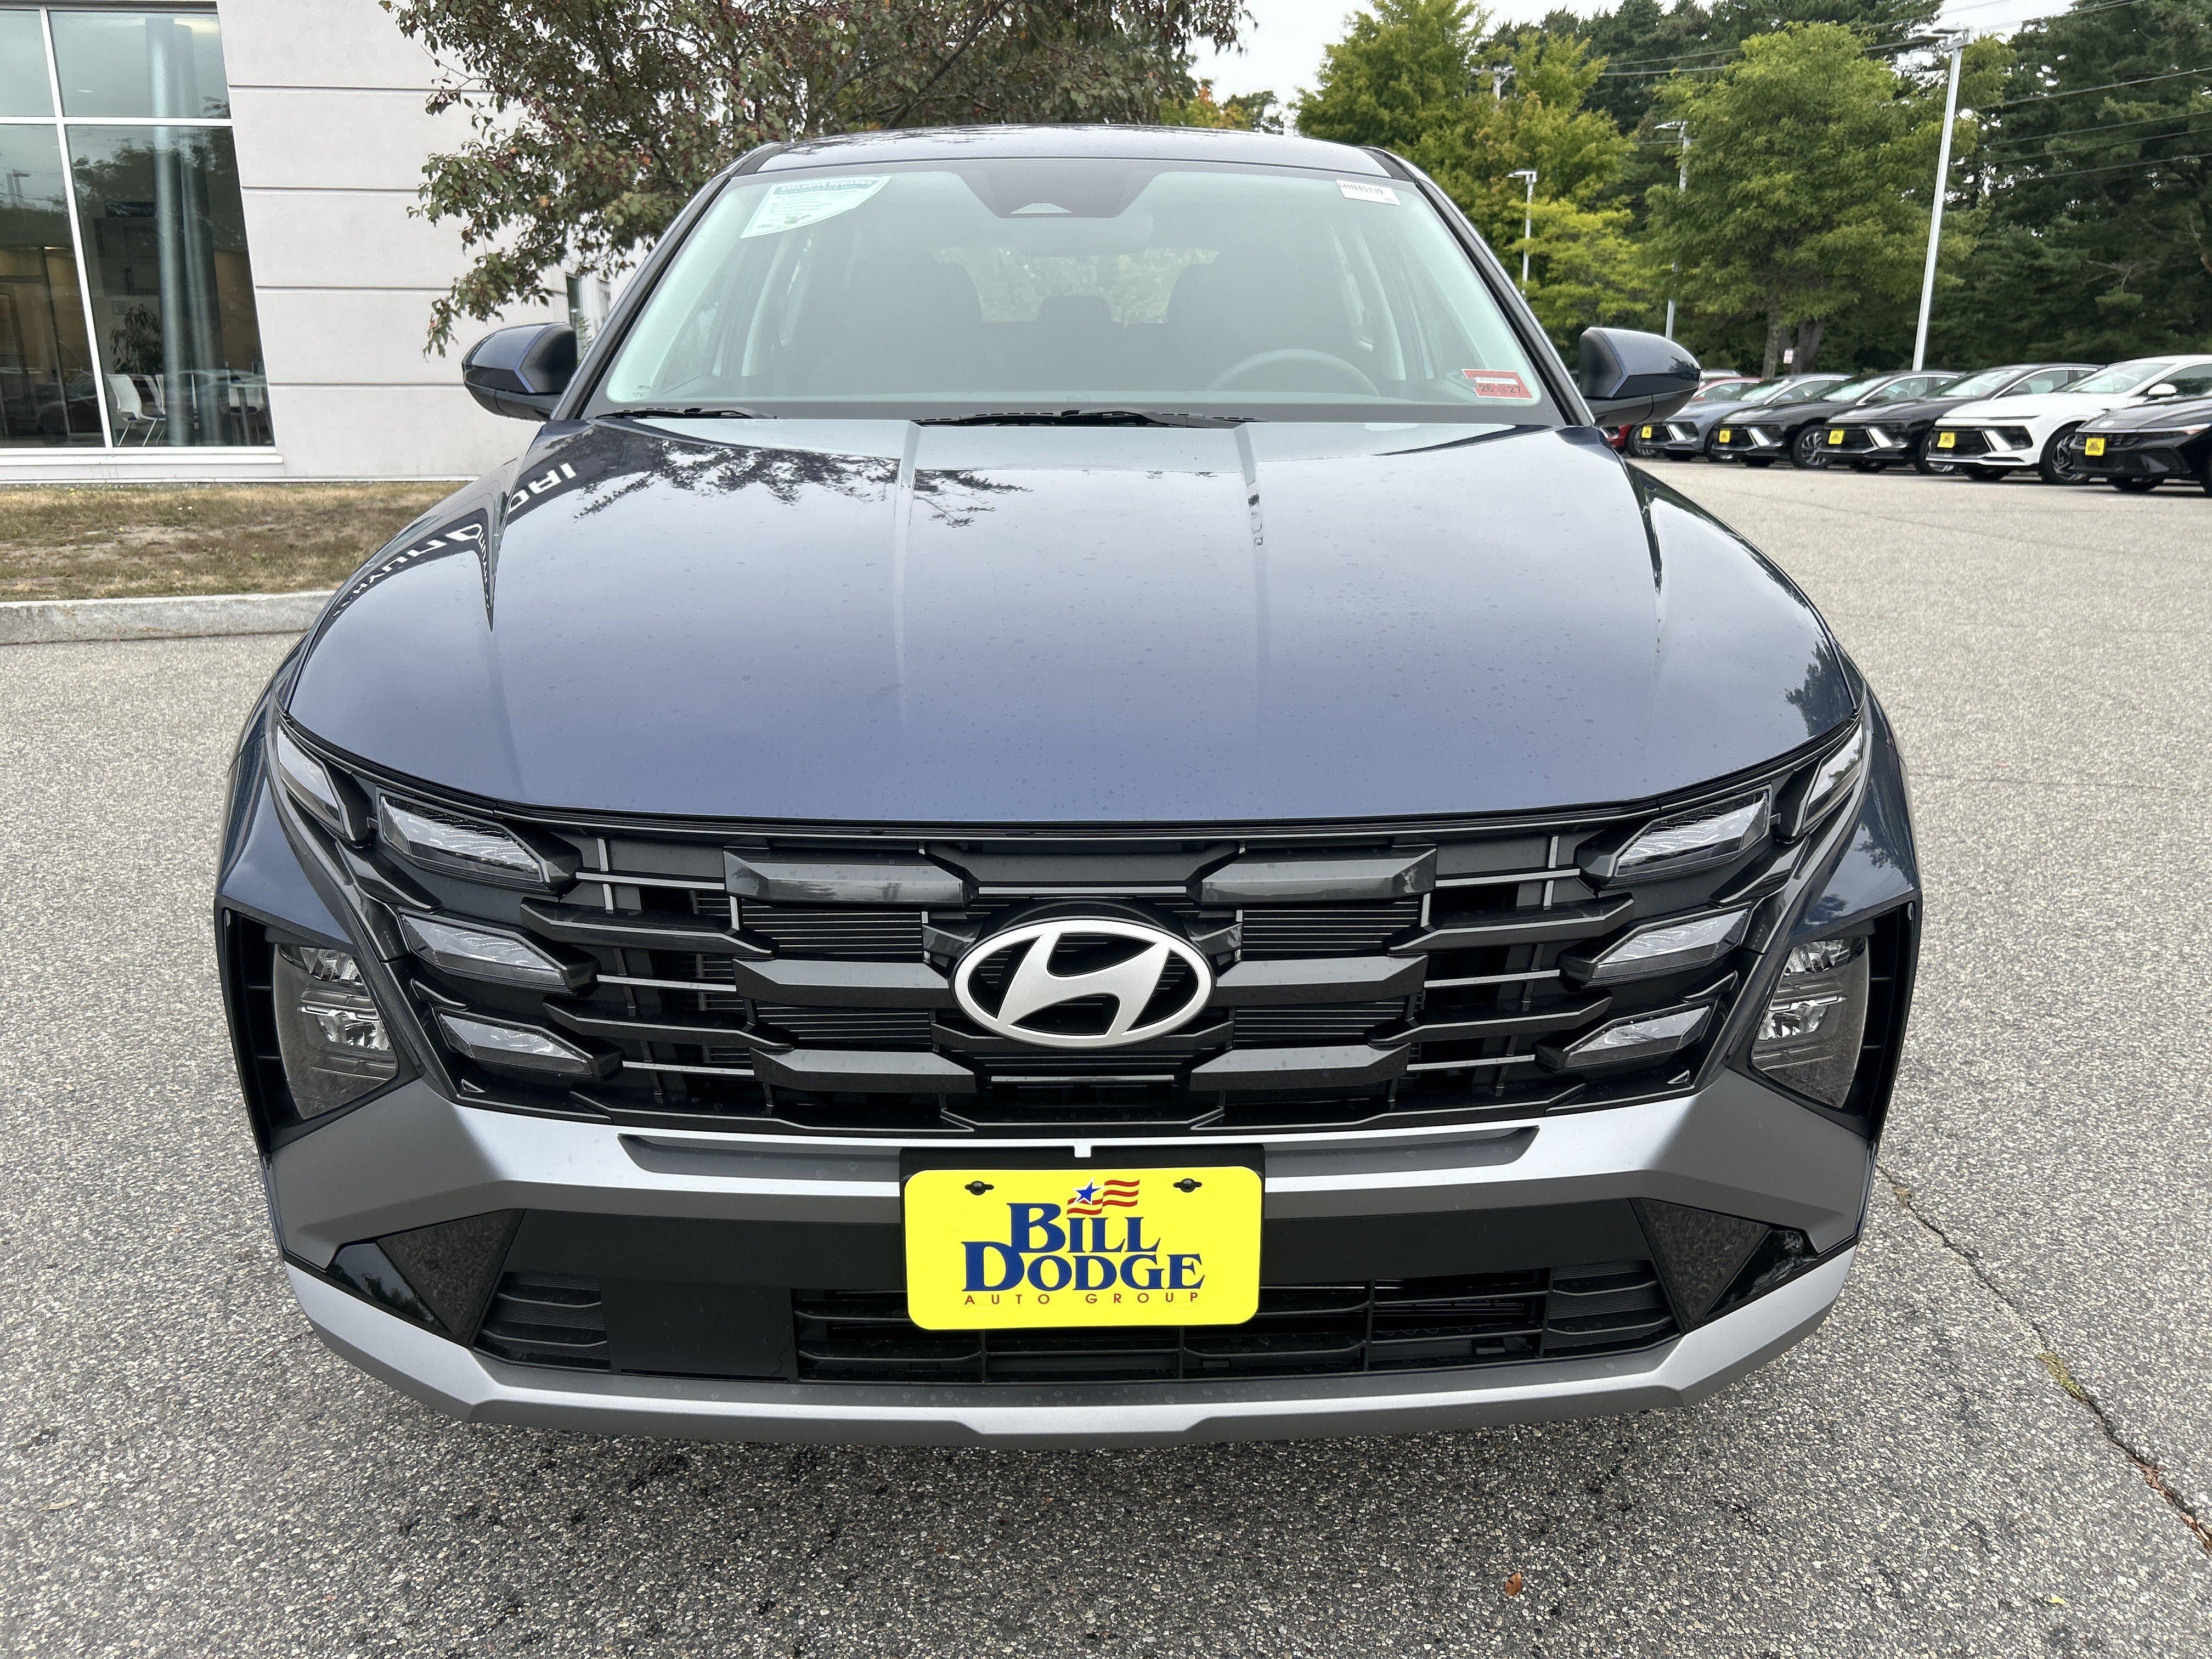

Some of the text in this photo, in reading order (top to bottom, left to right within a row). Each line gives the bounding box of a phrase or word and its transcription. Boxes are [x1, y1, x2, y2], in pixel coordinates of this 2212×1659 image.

[1479, 385, 1521, 394] 26 27
[1006, 1203, 1161, 1254] BILL
[961, 1241, 1205, 1292] DODGE
[964, 1291, 1199, 1305] AUTO GROUP
